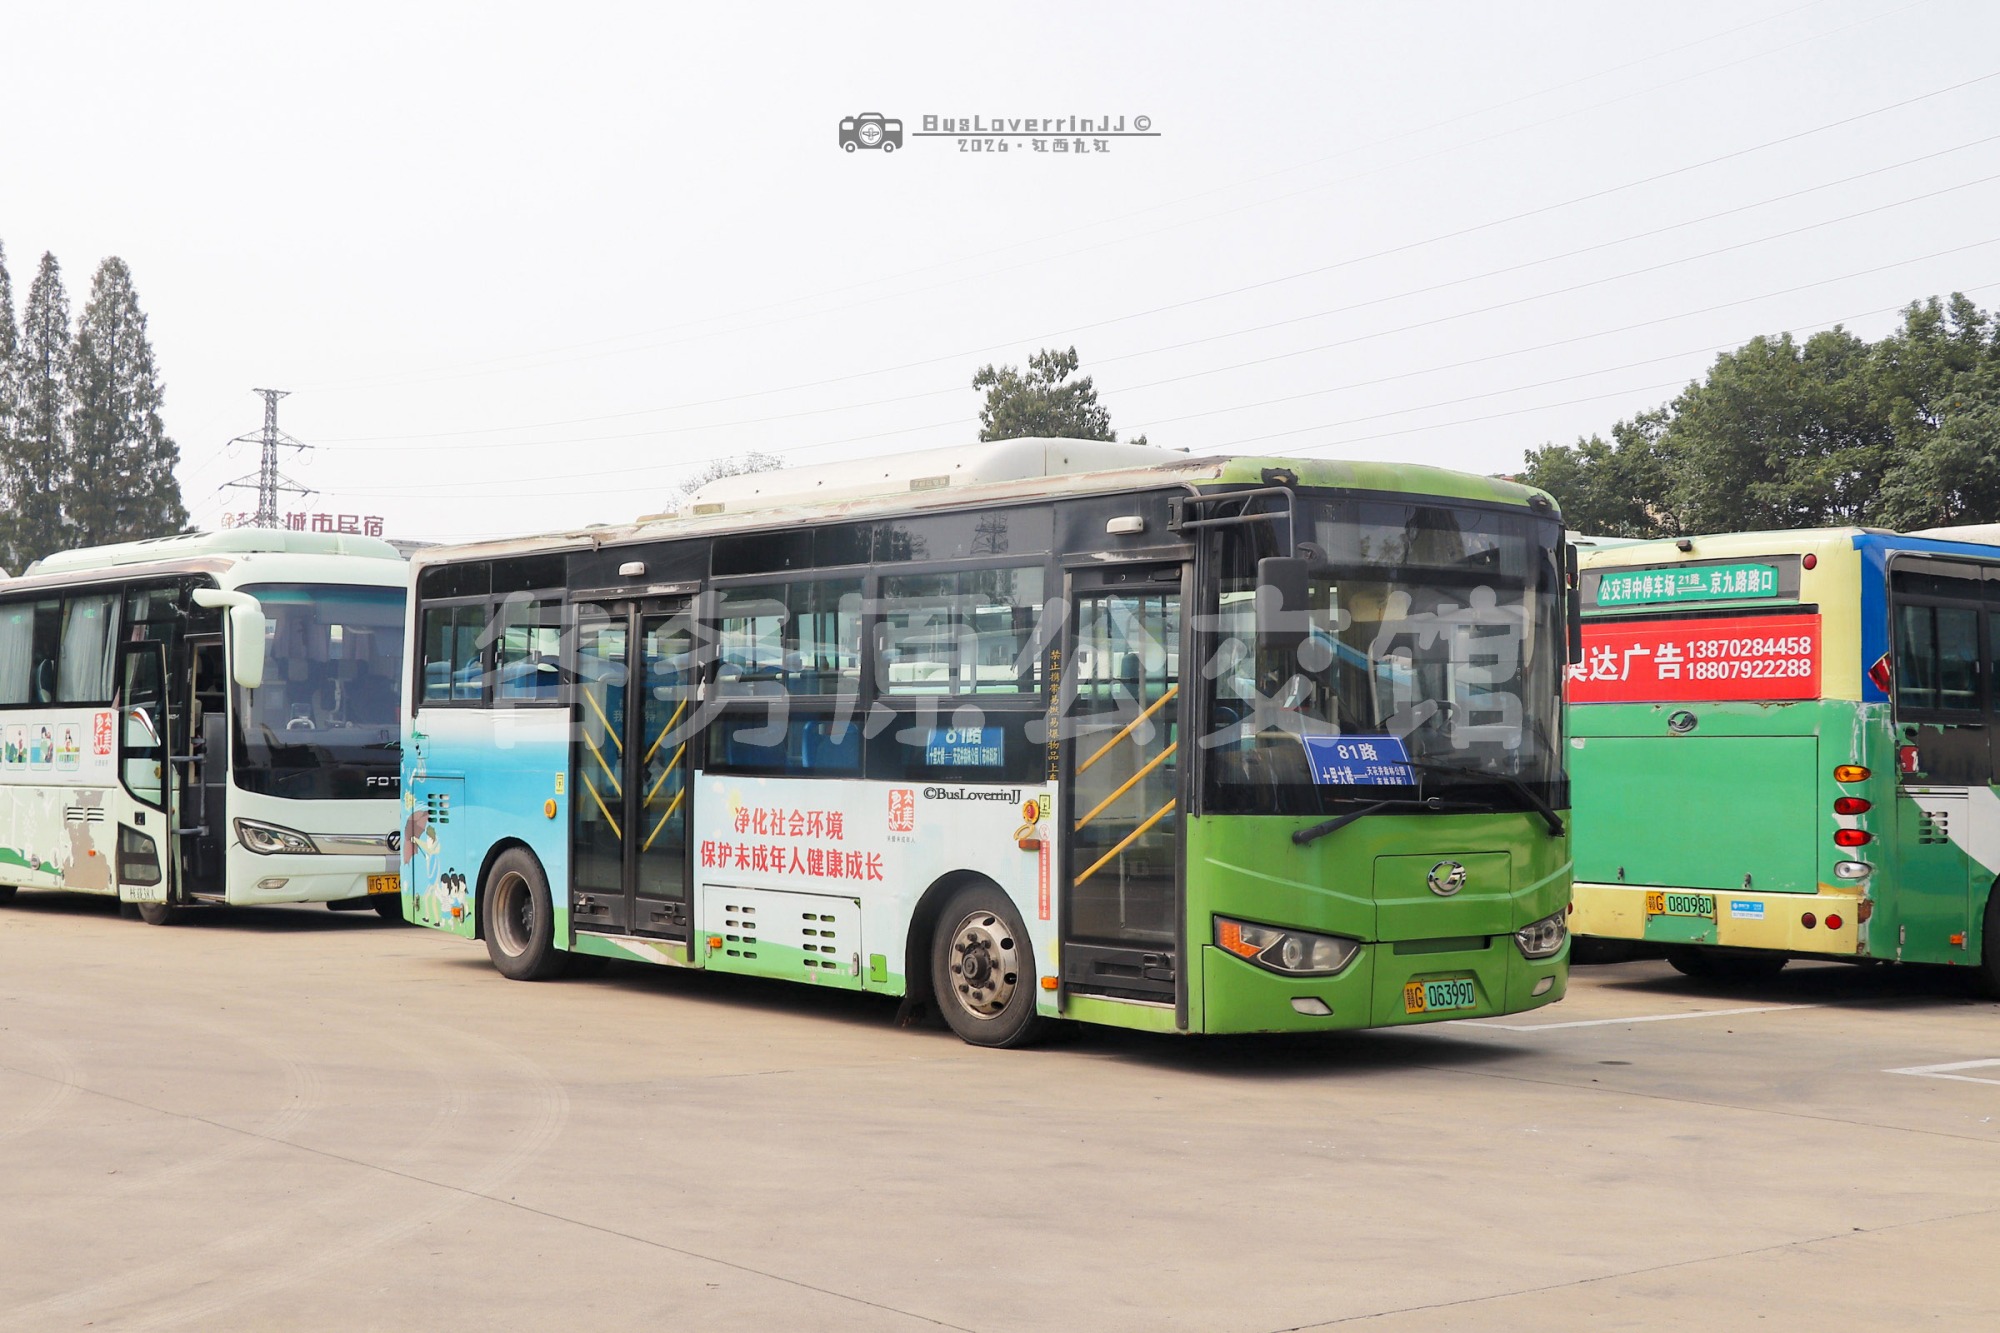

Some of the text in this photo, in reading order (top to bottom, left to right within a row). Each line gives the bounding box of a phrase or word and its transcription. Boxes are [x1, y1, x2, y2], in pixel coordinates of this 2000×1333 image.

[1601, 569, 1772, 600] 公交浔中停车场 21路 京九路路口
[1686, 636, 1812, 659] 13870284458
[1686, 659, 1812, 680] 18807922288
[1337, 742, 1378, 761] 81路
[734, 806, 844, 841] 净化社会环境
[701, 839, 883, 882] 保护未成年人健康成长
